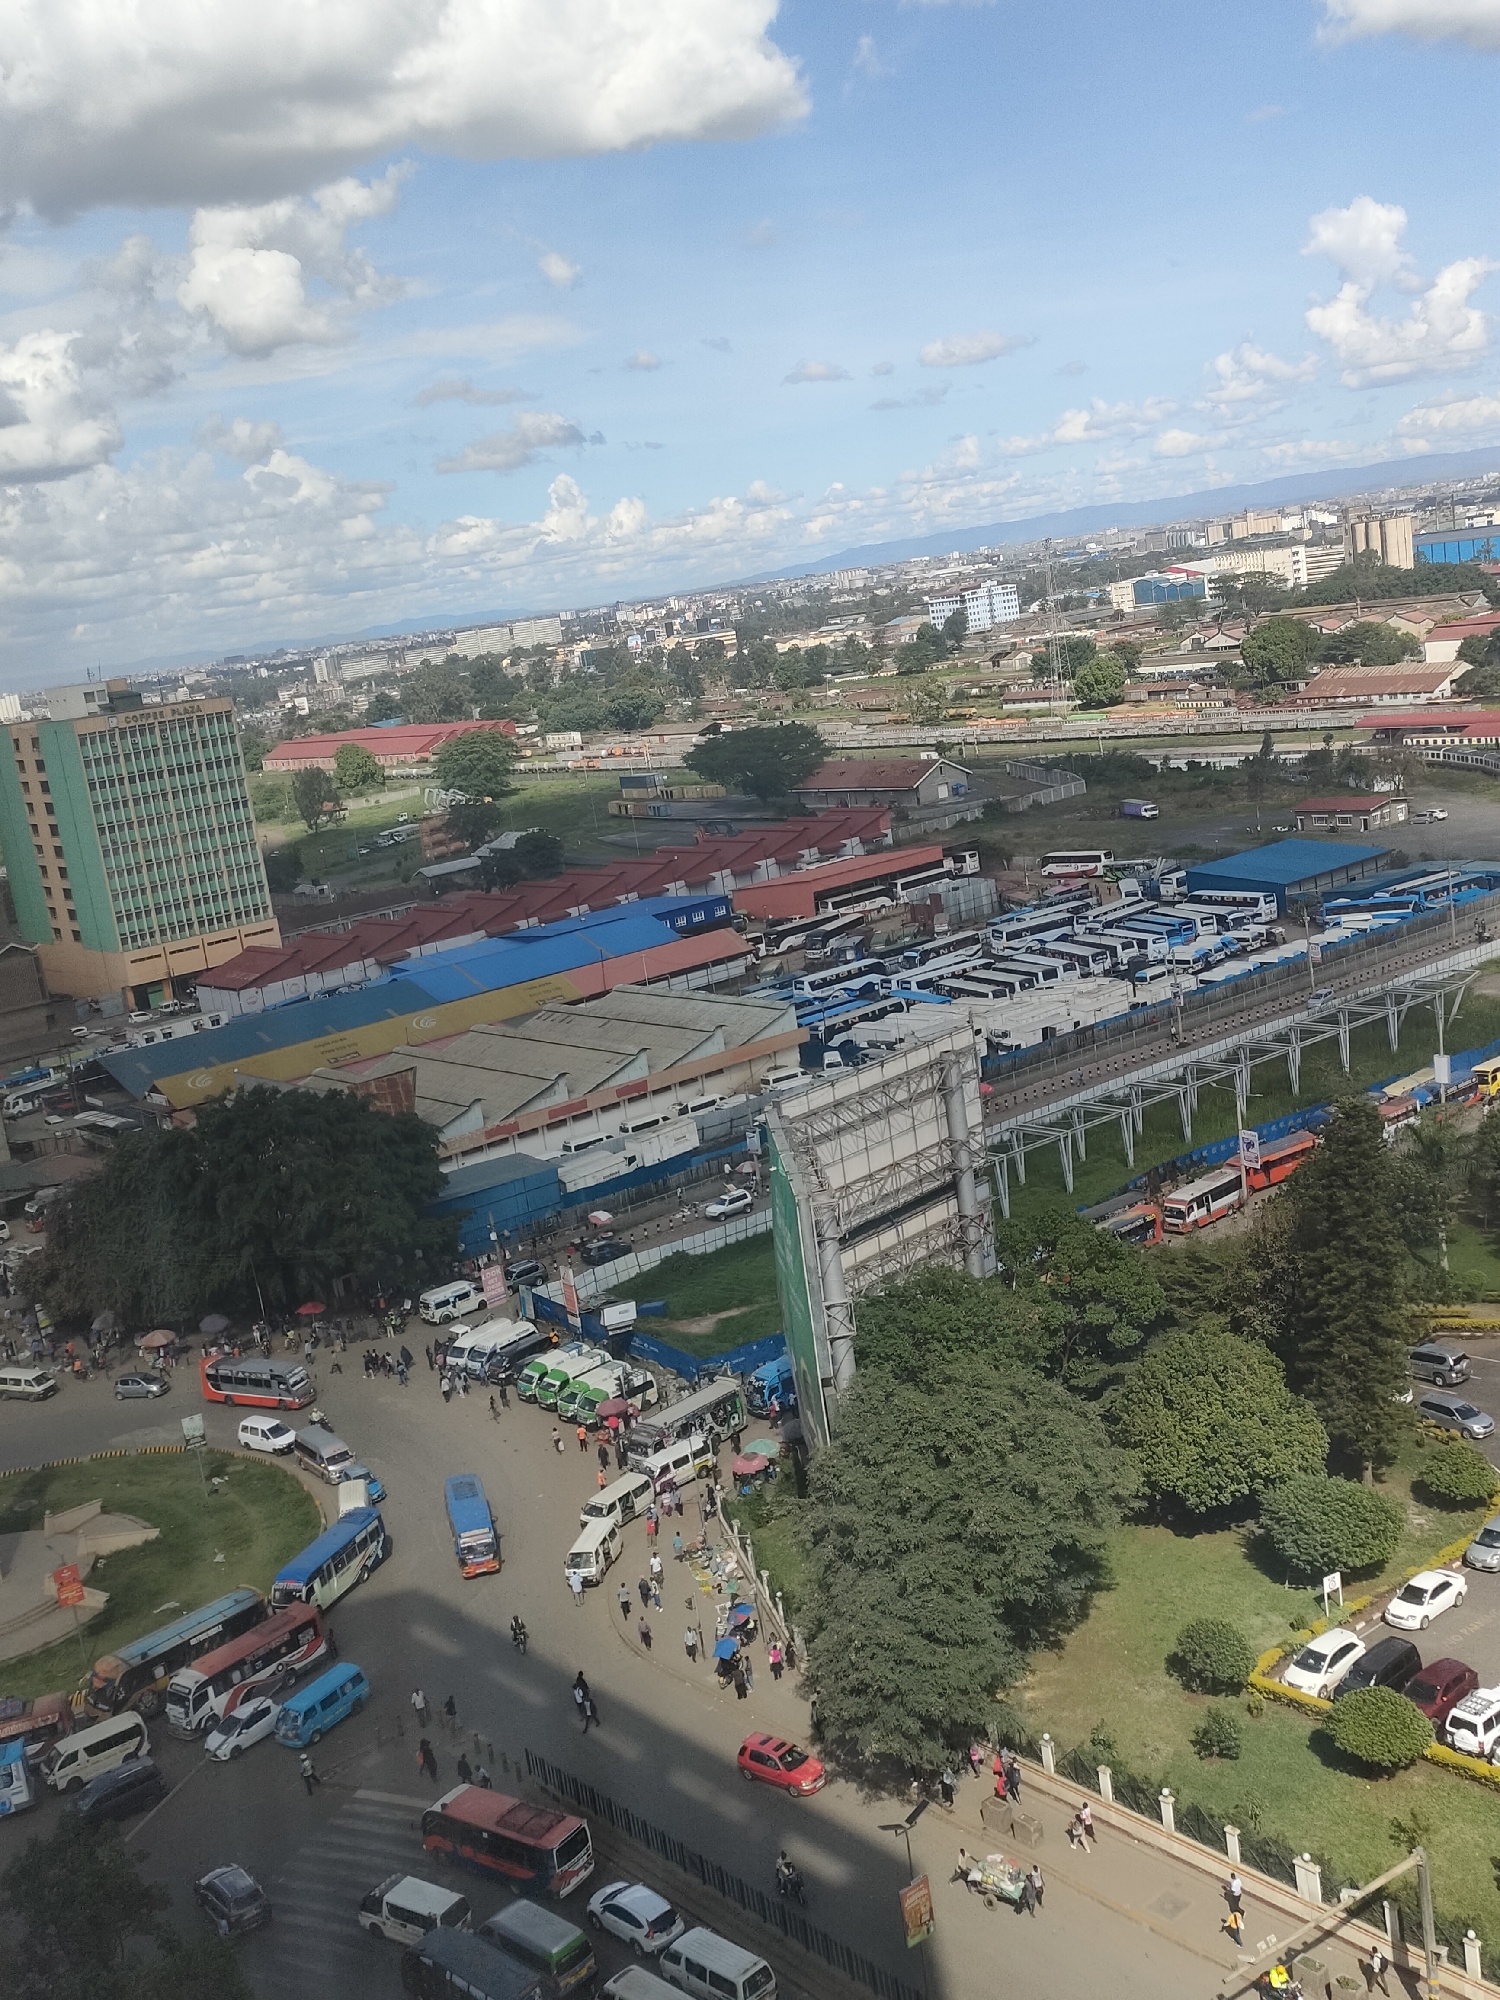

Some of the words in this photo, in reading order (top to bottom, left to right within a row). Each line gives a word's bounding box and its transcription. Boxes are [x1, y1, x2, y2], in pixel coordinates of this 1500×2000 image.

[124, 710, 165, 724] COFFEE
[170, 704, 202, 717] PLAZA
[1201, 895, 1254, 903] ANGEL
[813, 966, 870, 985] ANGEL
[481, 1267, 502, 1280] LOOK
